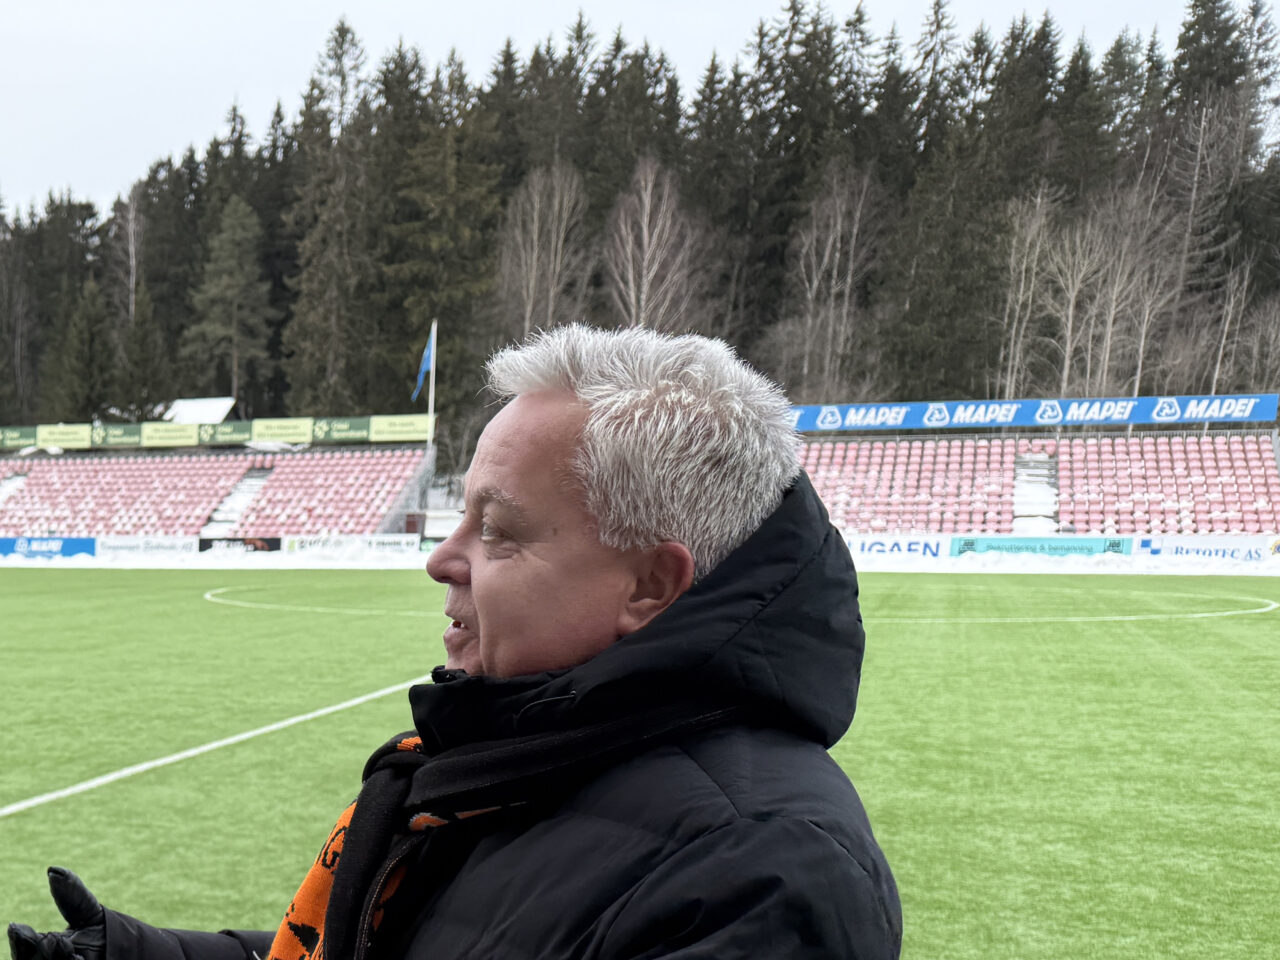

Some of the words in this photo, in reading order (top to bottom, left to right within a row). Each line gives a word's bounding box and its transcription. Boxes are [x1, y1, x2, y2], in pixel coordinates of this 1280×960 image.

[844, 406, 906, 426] MAPEI
[951, 404, 1018, 423] MAPEI
[1065, 401, 1134, 421] MAPEI
[1184, 398, 1255, 418] MAPEI
[1243, 548, 1264, 561] AS
